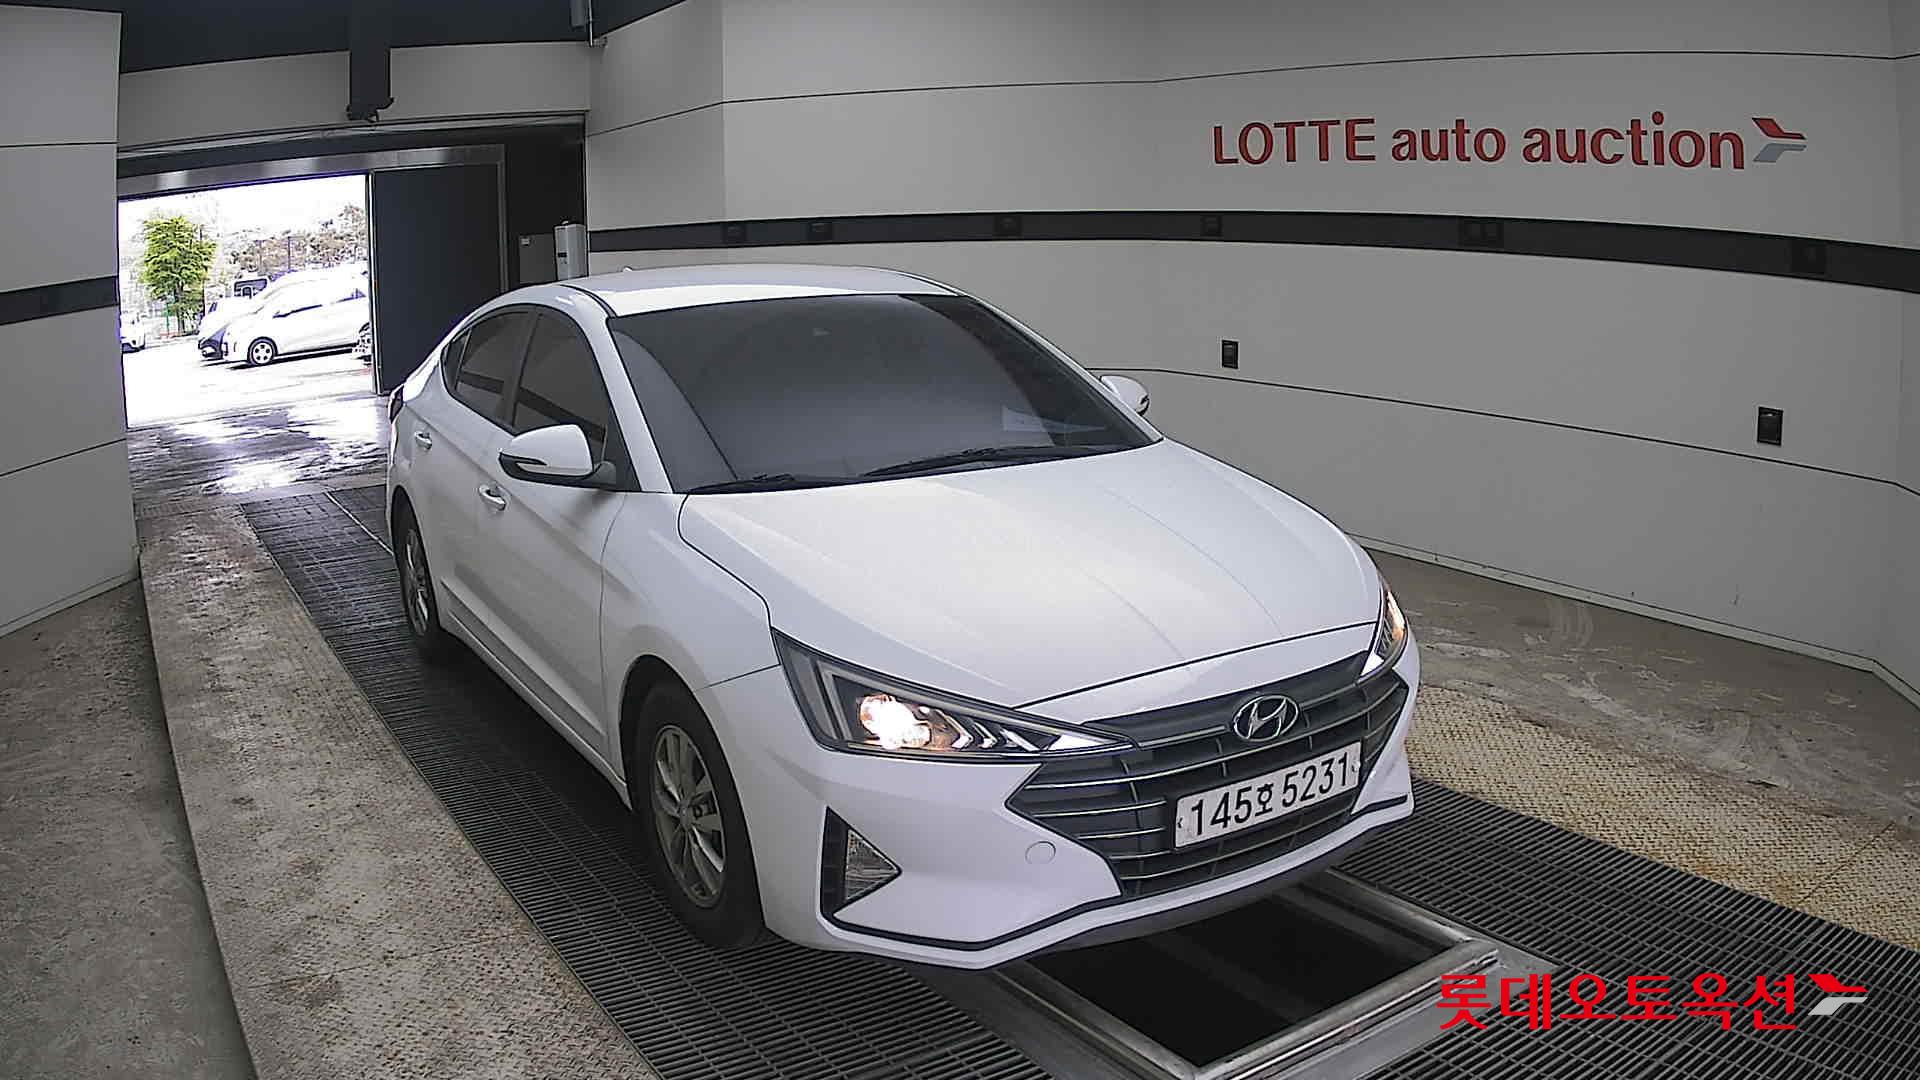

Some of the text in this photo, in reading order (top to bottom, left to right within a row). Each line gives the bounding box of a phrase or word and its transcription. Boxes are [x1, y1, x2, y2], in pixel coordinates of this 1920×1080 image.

[1213, 111, 1745, 169] LOTTE auto auction
[1191, 752, 1348, 835] 145호 5231
